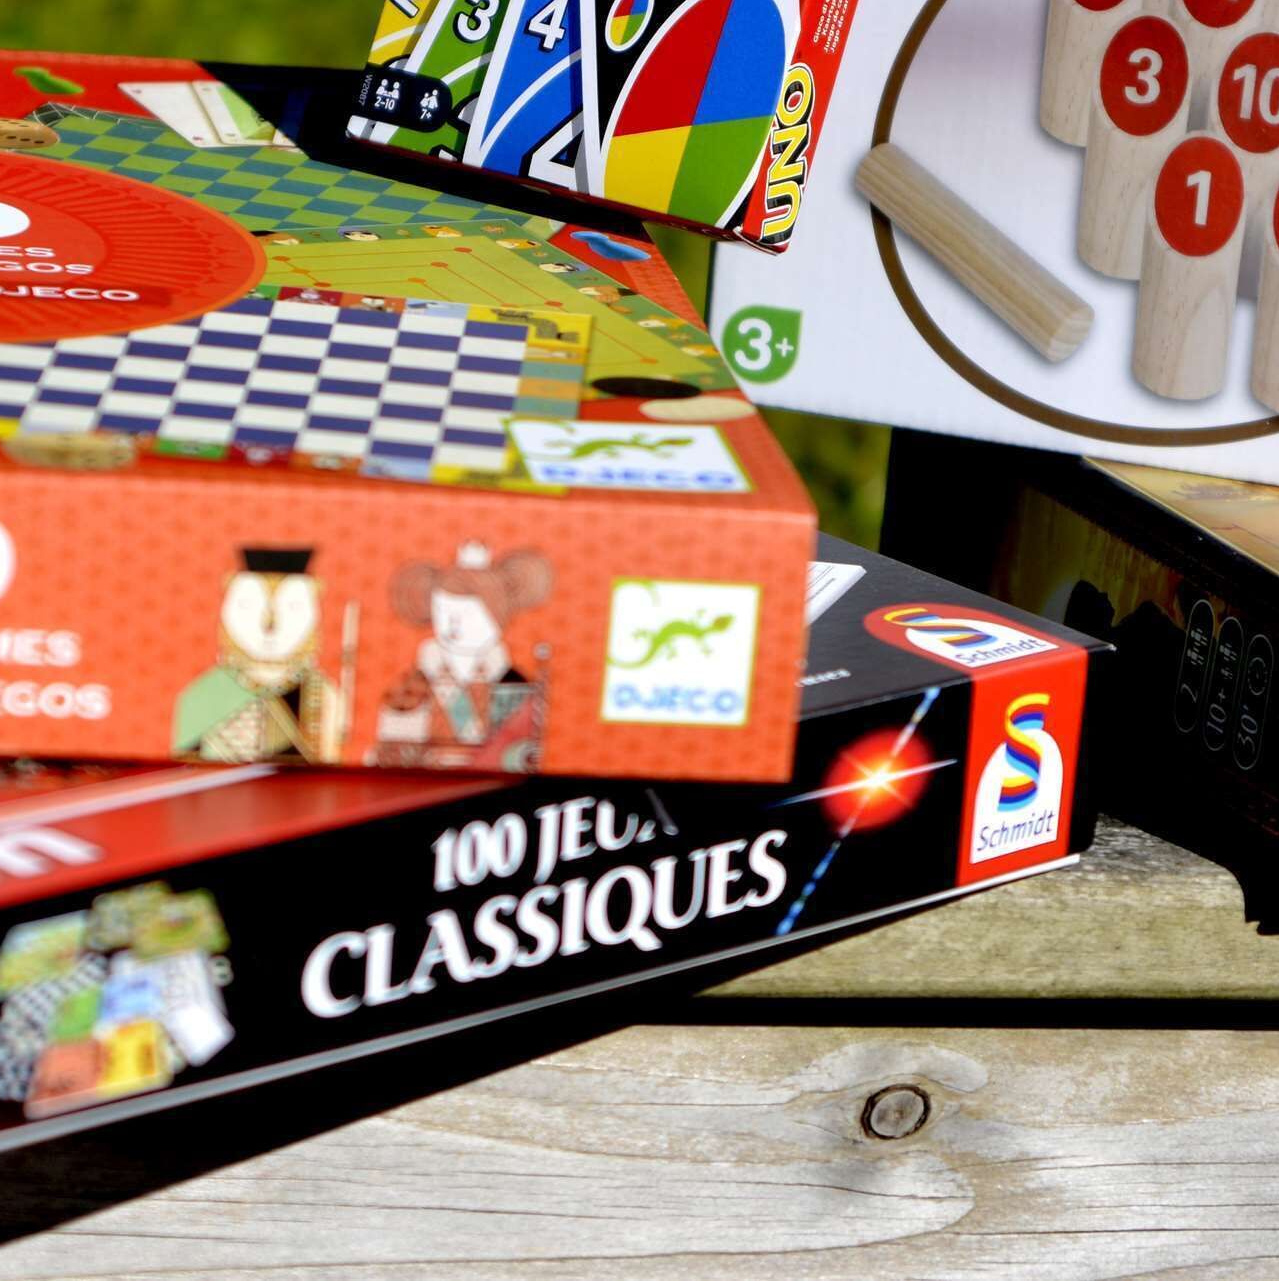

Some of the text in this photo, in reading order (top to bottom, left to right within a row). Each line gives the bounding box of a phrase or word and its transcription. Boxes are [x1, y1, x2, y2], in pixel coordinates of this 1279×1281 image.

[374, 96, 396, 110] 2-10
[1124, 47, 1163, 105] 3
[419, 108, 433, 120] 7+
[762, 65, 815, 244] UNO
[1187, 169, 1211, 227] 1
[733, 316, 795, 372] 3+
[956, 637, 1047, 666] Schmidt
[613, 683, 743, 715] DJECO
[432, 810, 523, 893] 100
[976, 810, 1056, 852] Schmidt
[300, 829, 789, 1019] CLASSIQUES
